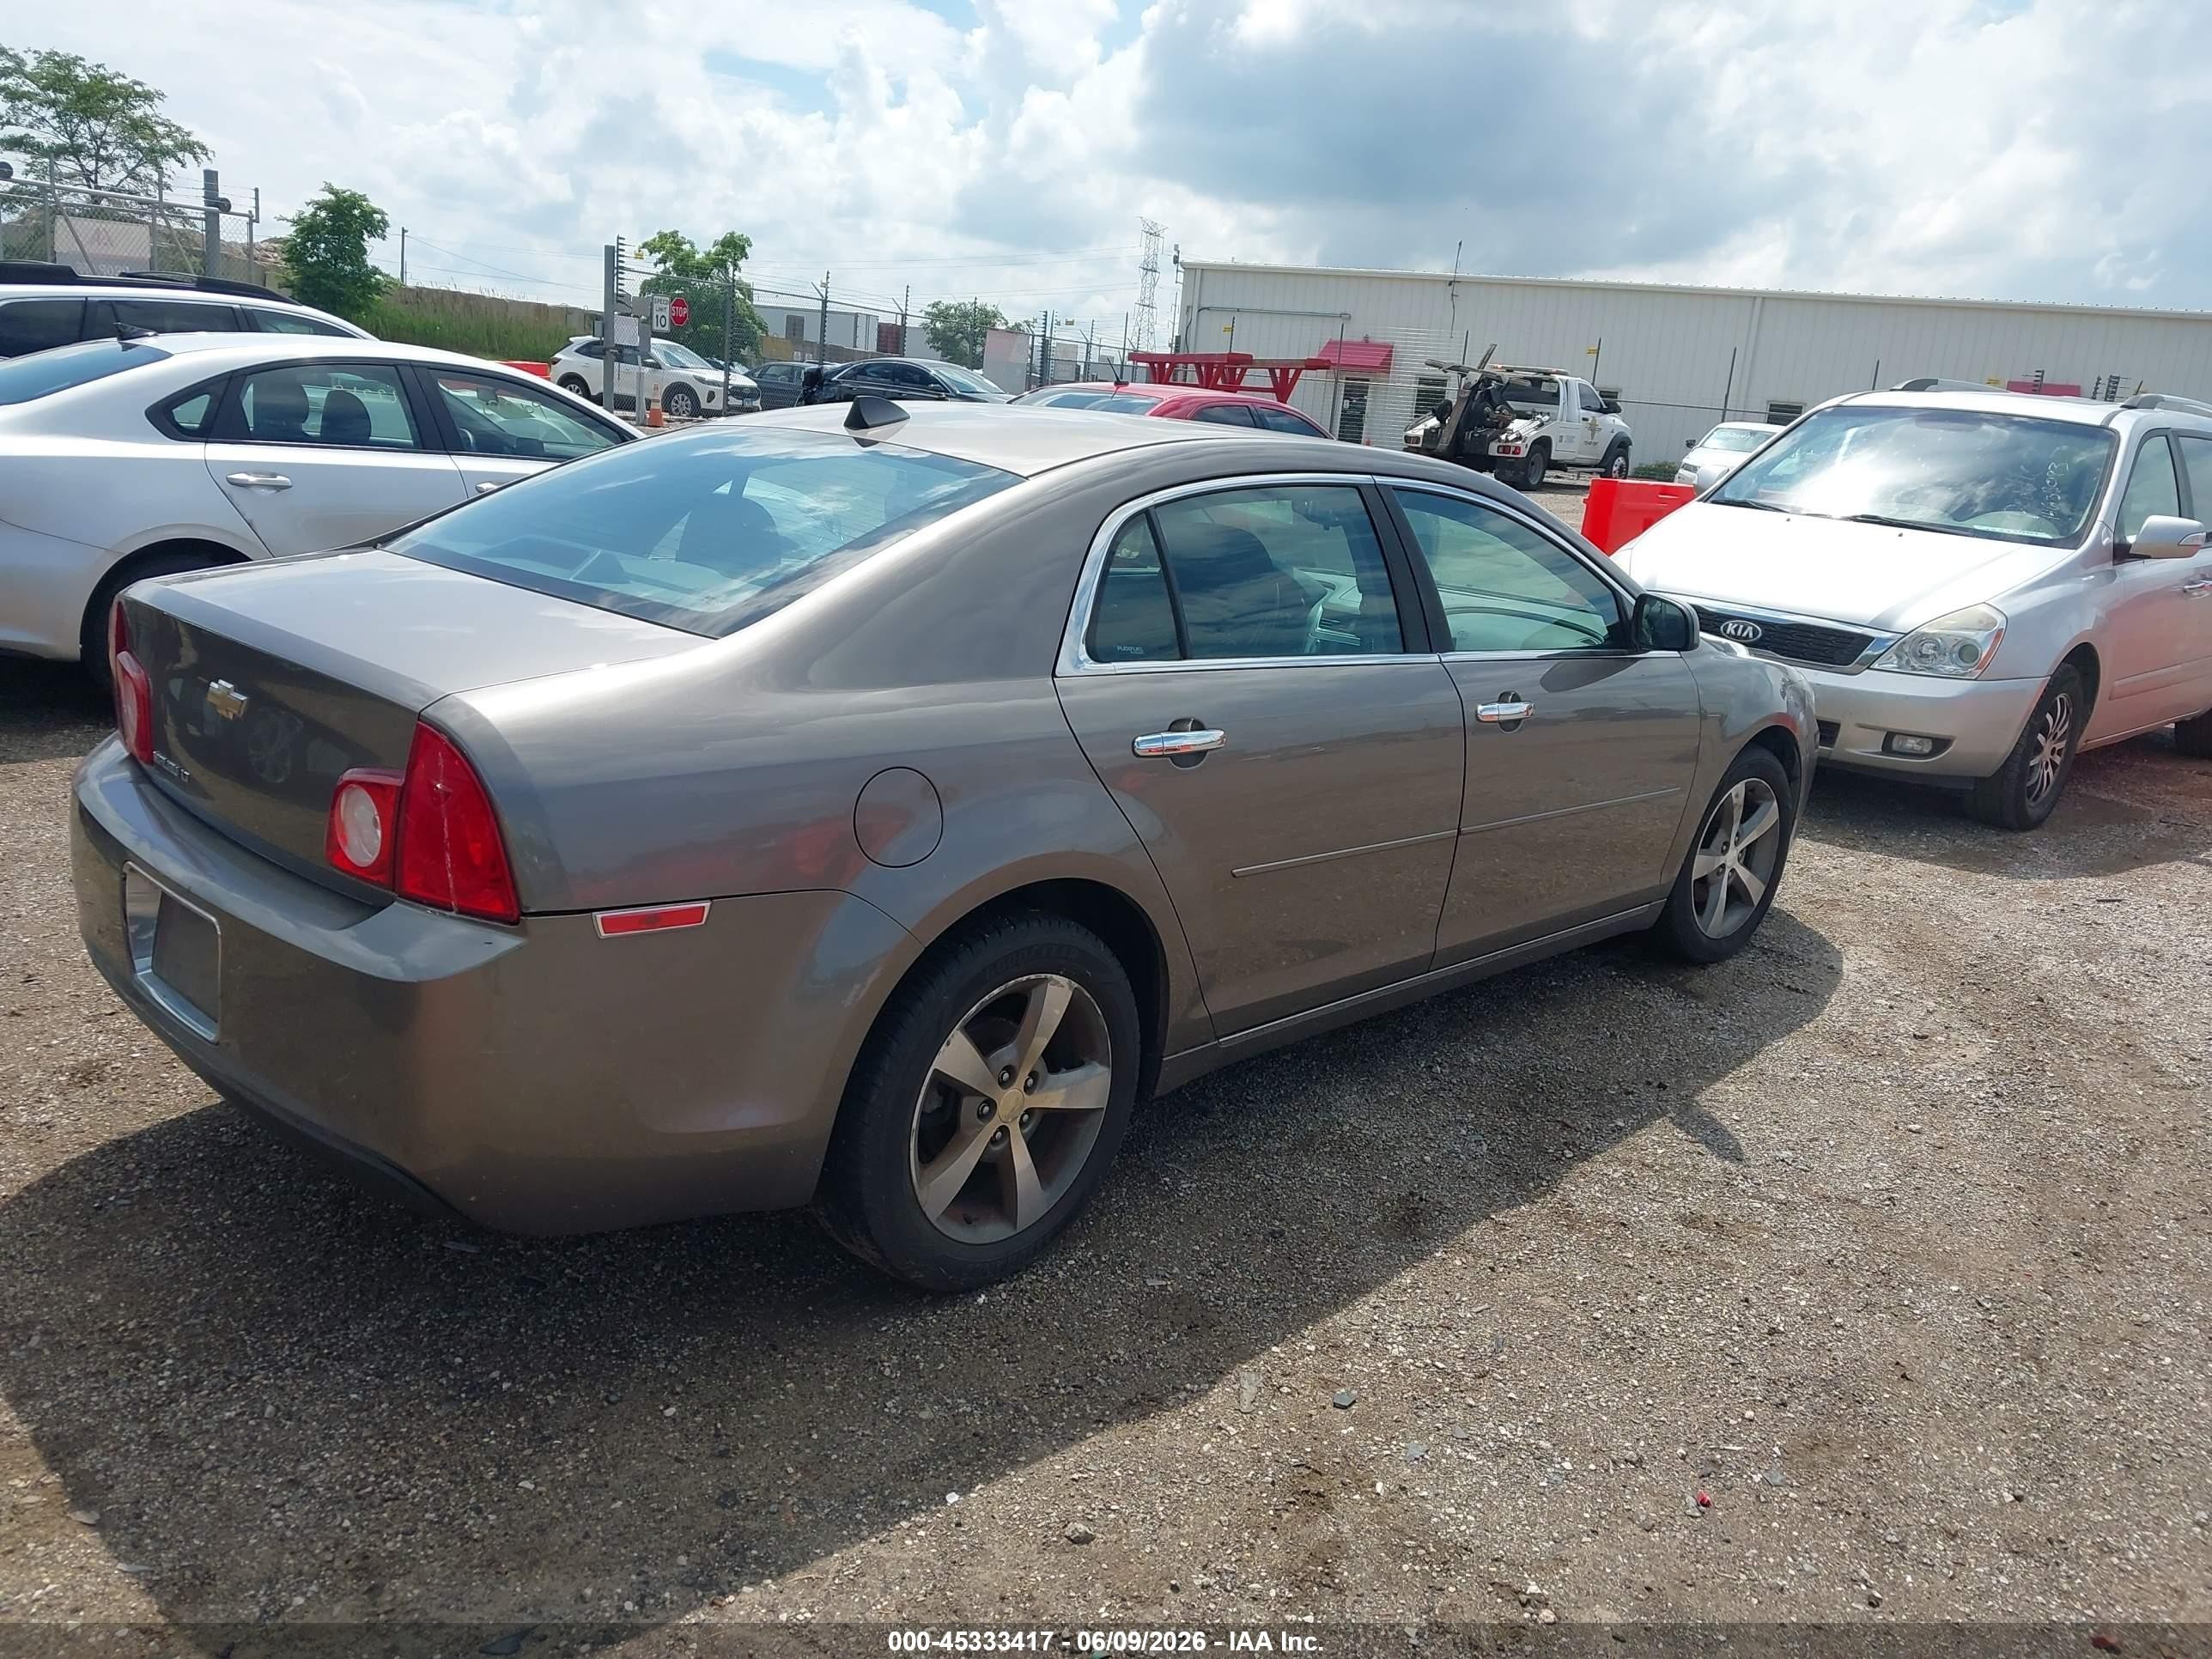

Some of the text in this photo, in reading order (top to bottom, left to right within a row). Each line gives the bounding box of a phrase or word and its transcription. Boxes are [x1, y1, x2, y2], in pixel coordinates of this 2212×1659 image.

[672, 306, 688, 317] STOP
[655, 314, 667, 328] 10
[1725, 623, 1754, 639] KIA
